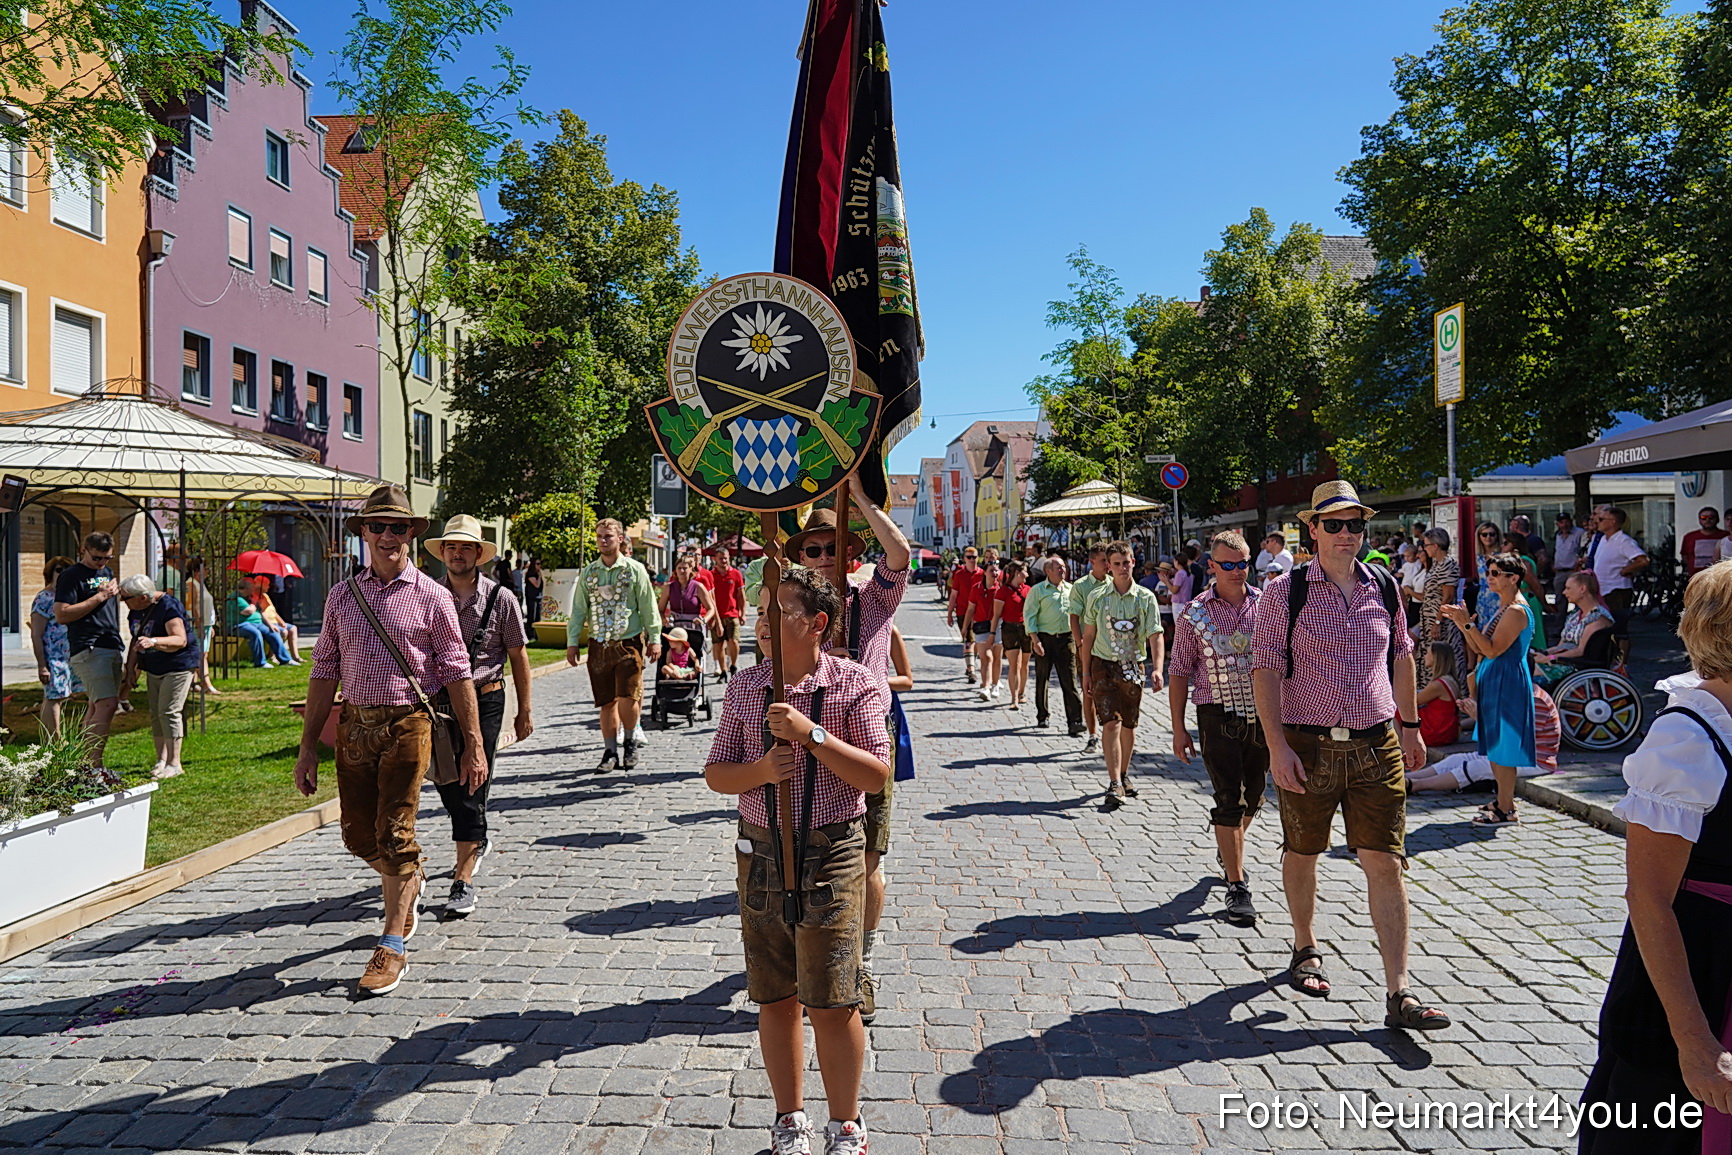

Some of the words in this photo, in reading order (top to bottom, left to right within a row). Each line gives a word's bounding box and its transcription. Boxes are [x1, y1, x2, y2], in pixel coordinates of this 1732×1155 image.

[831, 267, 870, 297] 1963
[1604, 445, 1649, 467] LORENZO
[951, 486, 962, 510] SALE
